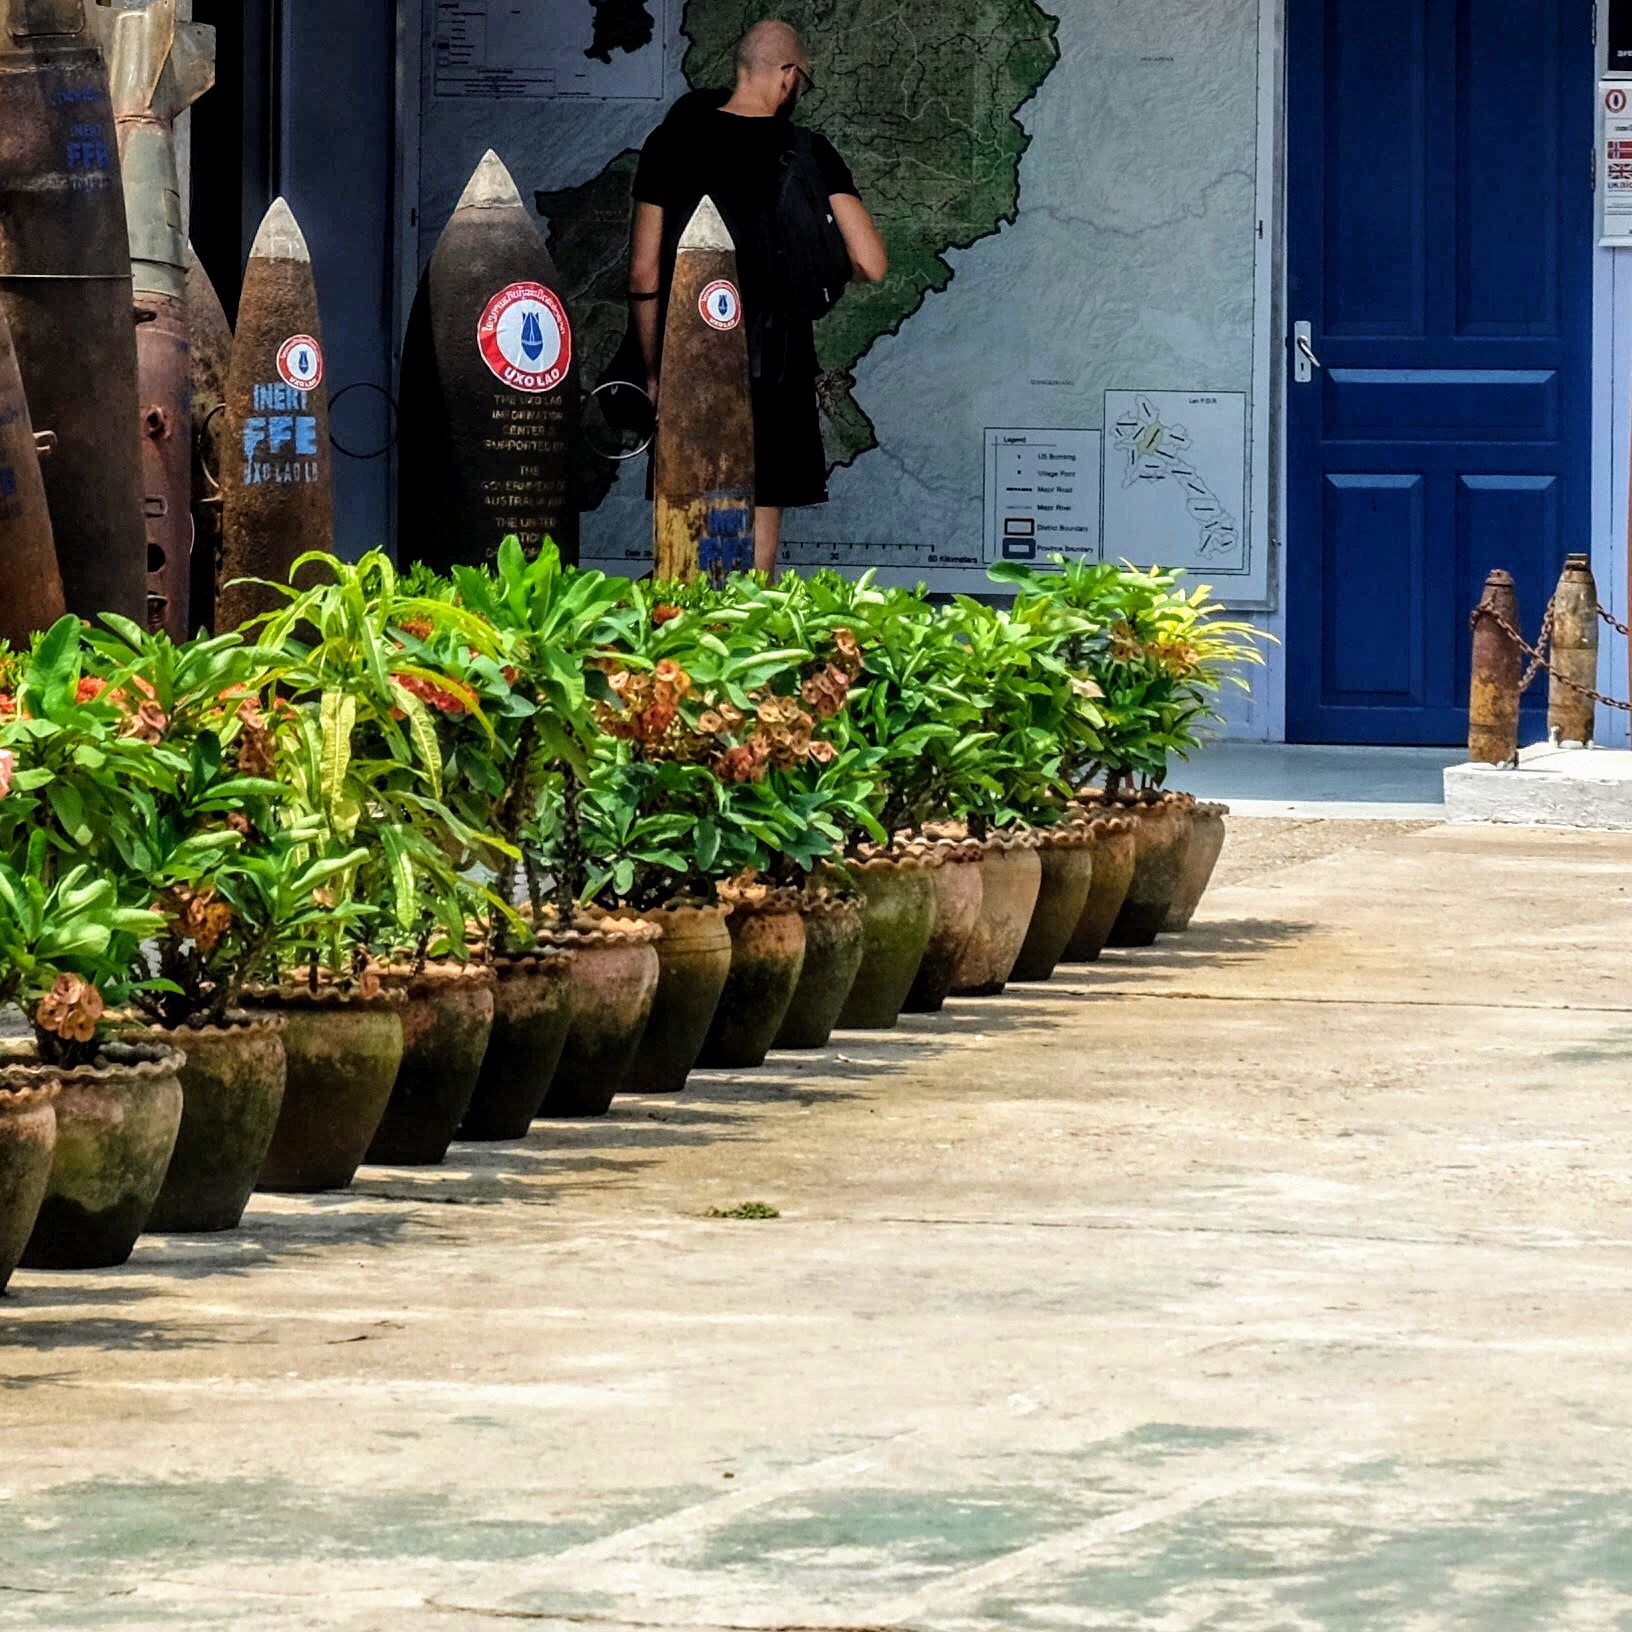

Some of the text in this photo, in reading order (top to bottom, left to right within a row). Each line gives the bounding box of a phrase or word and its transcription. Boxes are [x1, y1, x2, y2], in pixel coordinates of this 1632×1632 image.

[504, 367, 560, 387] UXO LAO
[243, 417, 317, 454] FFE
[502, 424, 545, 436] CENTER
